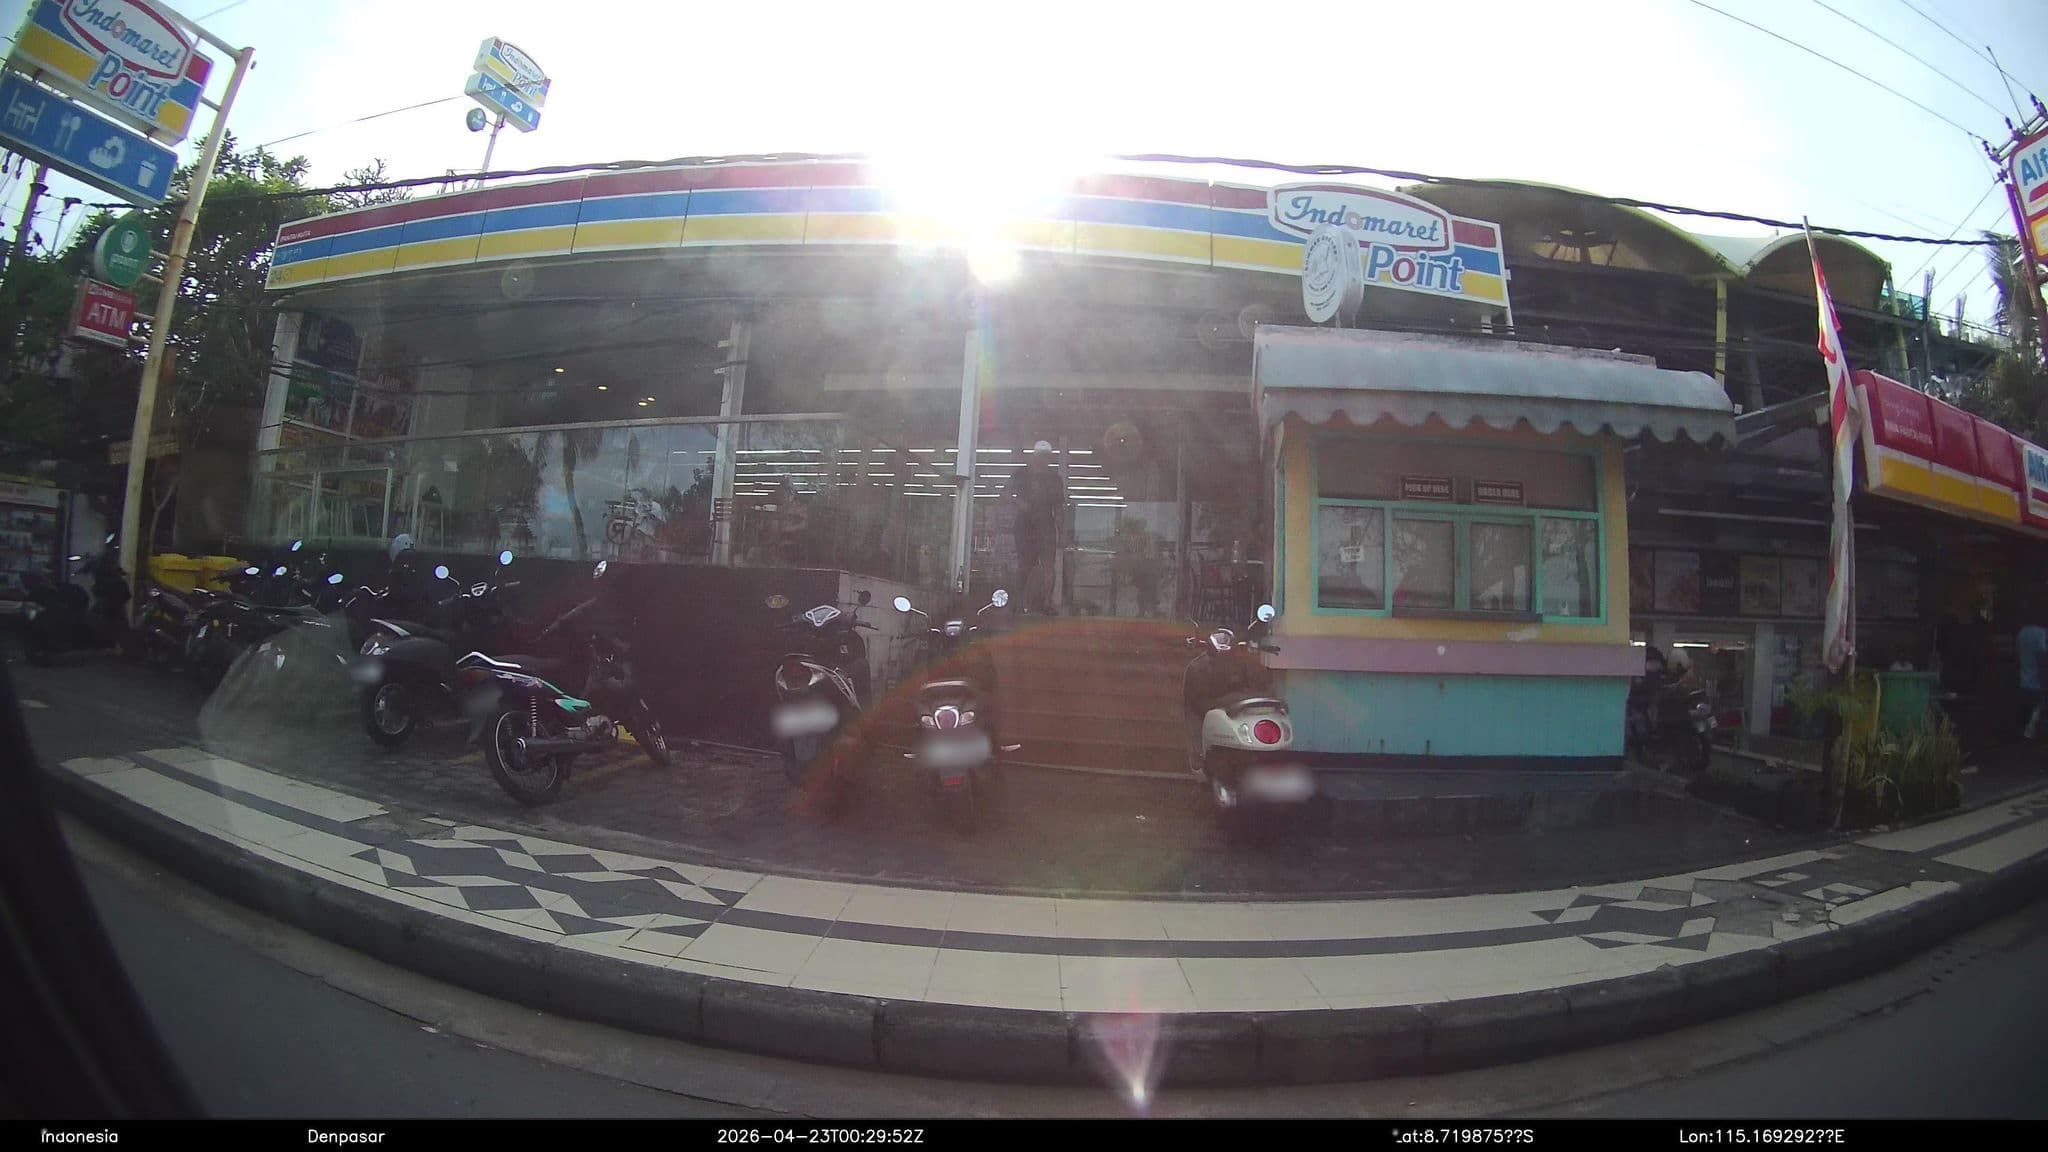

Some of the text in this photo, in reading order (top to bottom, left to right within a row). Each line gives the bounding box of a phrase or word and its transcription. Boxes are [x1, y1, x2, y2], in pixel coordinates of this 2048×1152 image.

[73, 0, 181, 69] Indomaret
[89, 55, 169, 118] Point
[1284, 196, 1441, 242] Indomaret
[1367, 244, 1464, 292] Point
[88, 302, 127, 330] ATM
